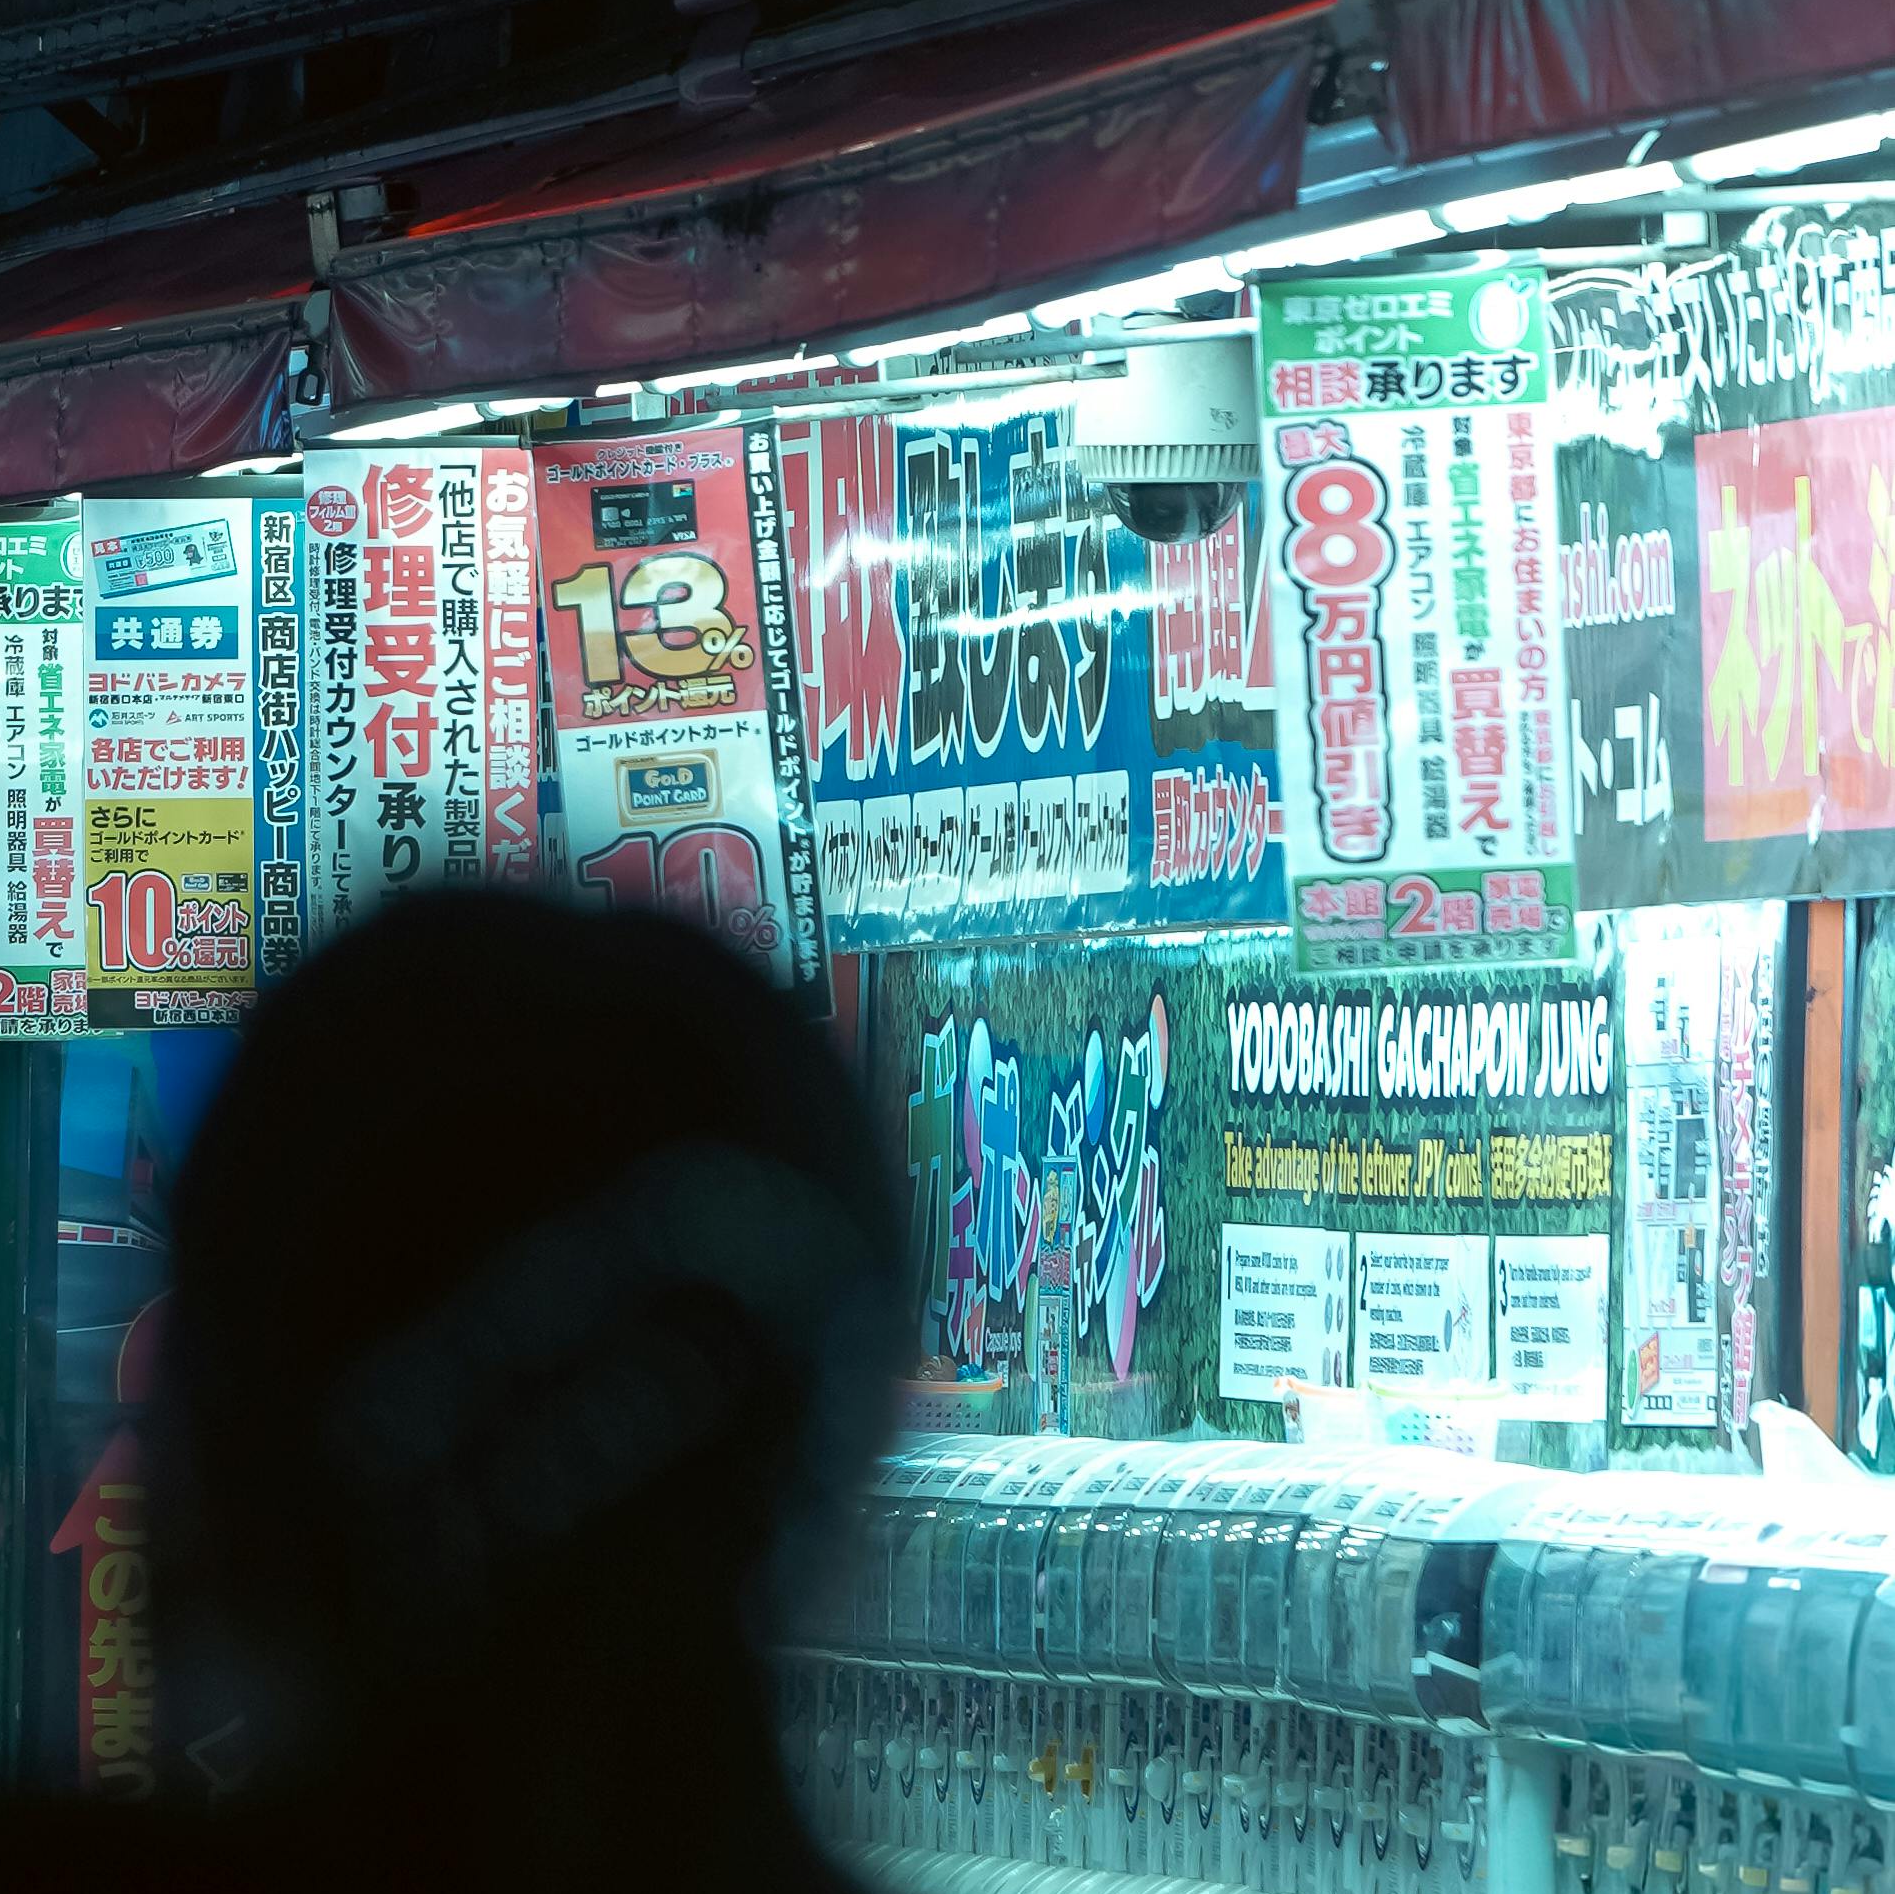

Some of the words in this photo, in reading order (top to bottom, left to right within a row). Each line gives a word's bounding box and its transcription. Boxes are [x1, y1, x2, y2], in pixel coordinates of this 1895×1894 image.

[1273, 354, 1532, 409] 相談承ります
[111, 615, 223, 650] 共通券
[89, 672, 247, 692] ヨドバシカメラ
[184, 713, 205, 723] ART
[207, 713, 245, 723] SPORTS
[5, 705, 27, 780] エアコン
[90, 736, 245, 763] 各店でご利用
[6, 788, 28, 873] 照明器具
[90, 806, 157, 829] さらに
[90, 848, 150, 864] ご利用で
[177, 901, 249, 933] ポイント
[1227, 1001, 1371, 1097] YODOBASHI
[1377, 1001, 1530, 1100] GACHAPON
[1224, 1130, 1254, 1188] Take
[1255, 1132, 1320, 1206] advantage
[1338, 1137, 1359, 1195] the
[1360, 1138, 1413, 1197] leftover
